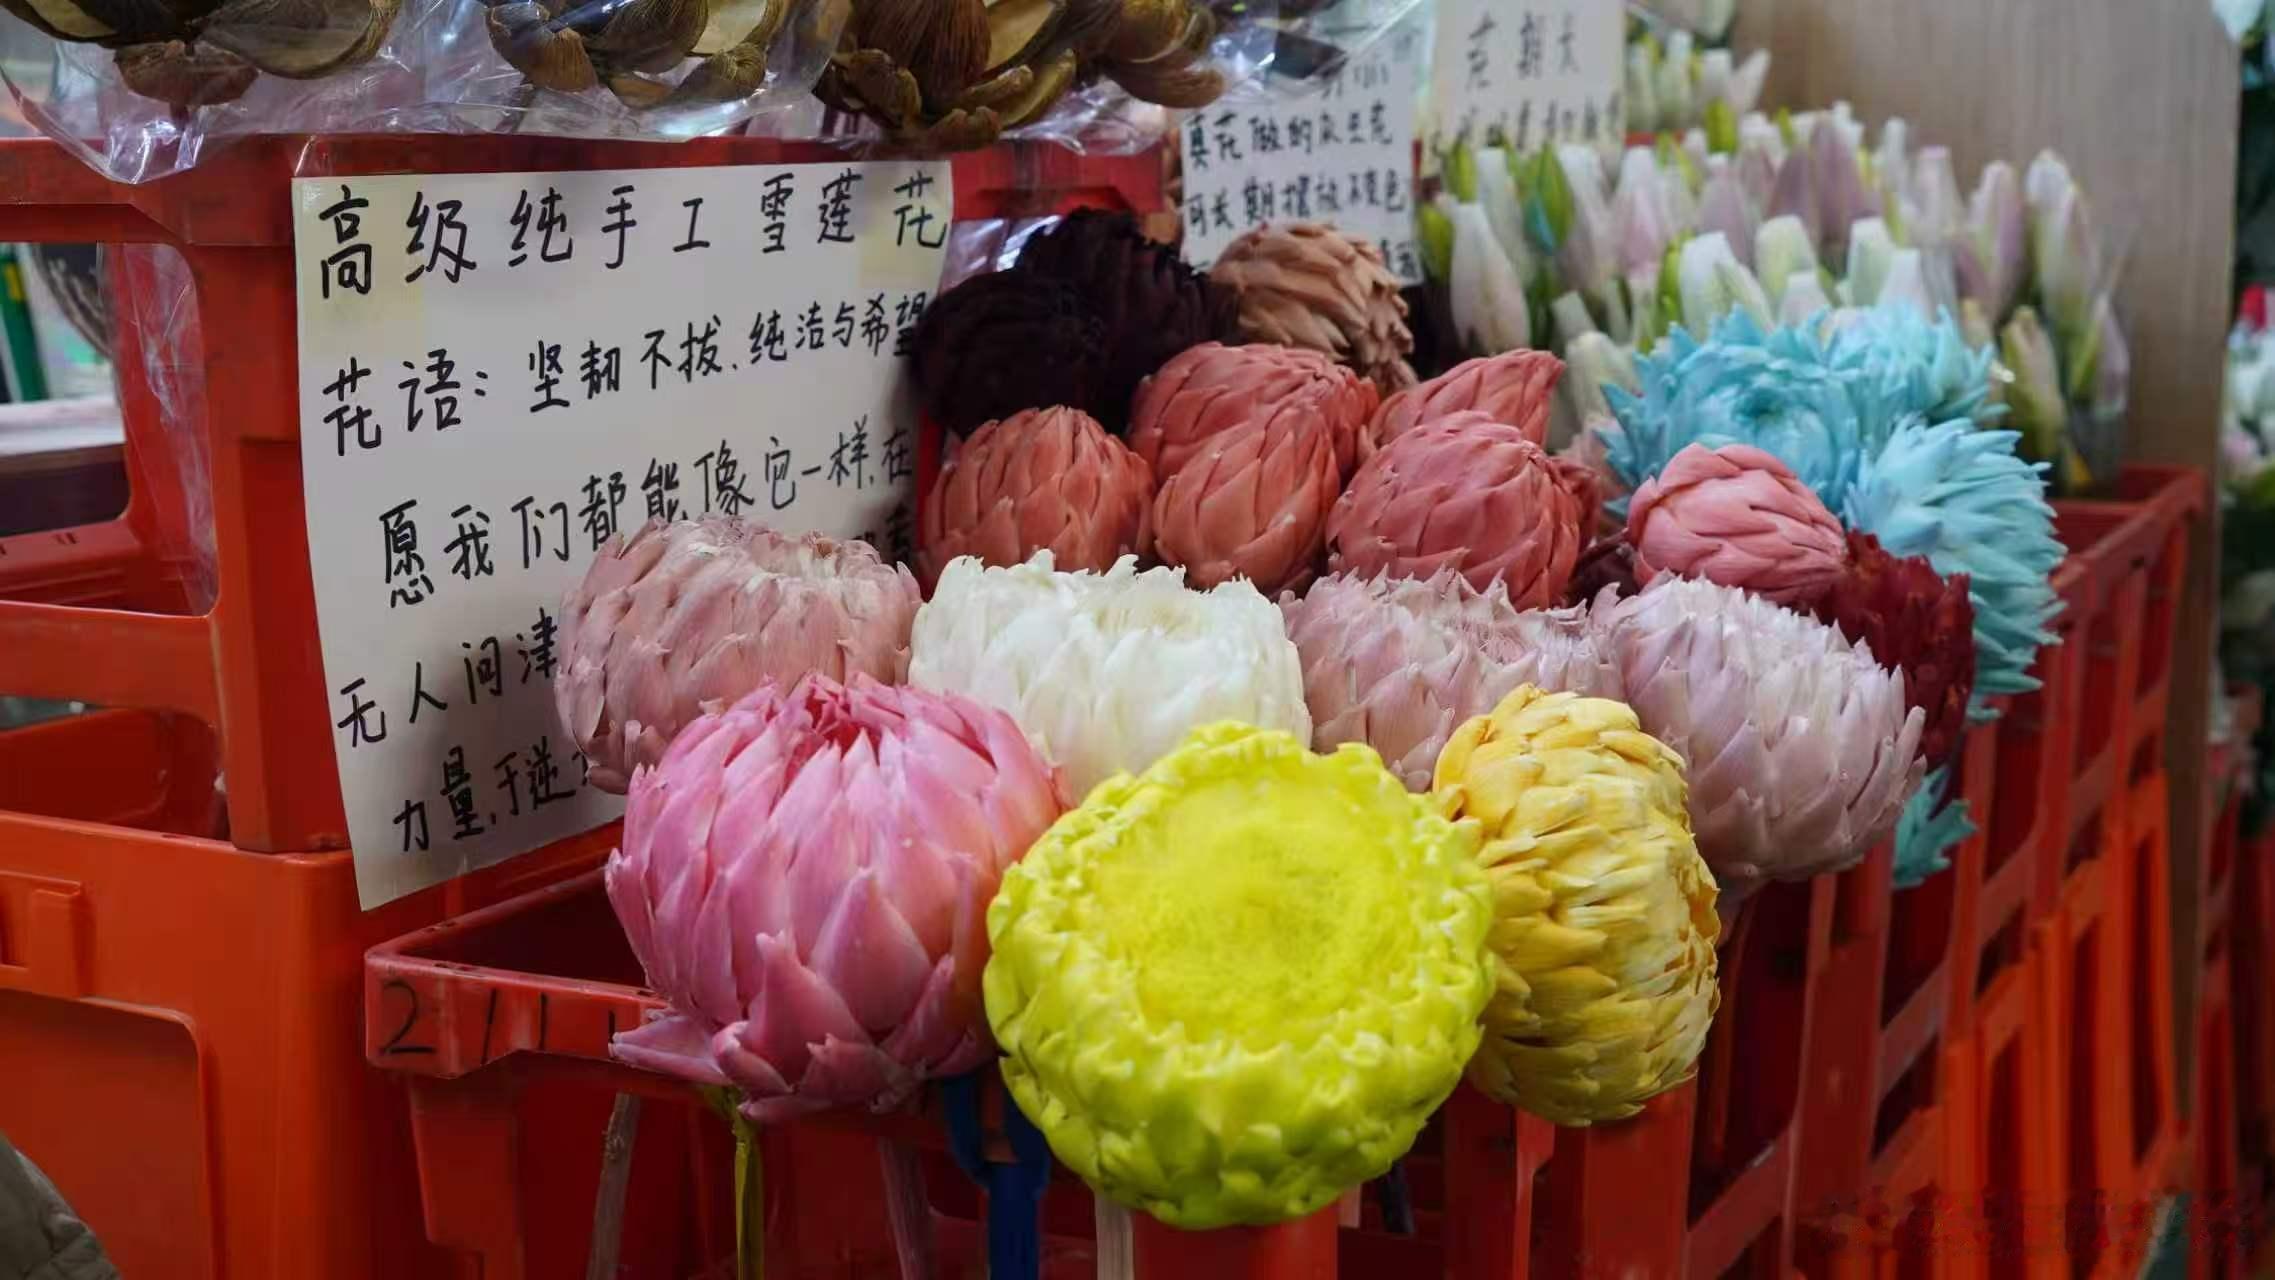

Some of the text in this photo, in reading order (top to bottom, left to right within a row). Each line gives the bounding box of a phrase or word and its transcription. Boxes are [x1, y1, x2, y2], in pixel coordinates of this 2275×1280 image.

[319, 168, 947, 299] 高级纯手工雪莲花
[337, 606, 558, 748] 无人问津
[393, 735, 588, 853] 力量，于逆
